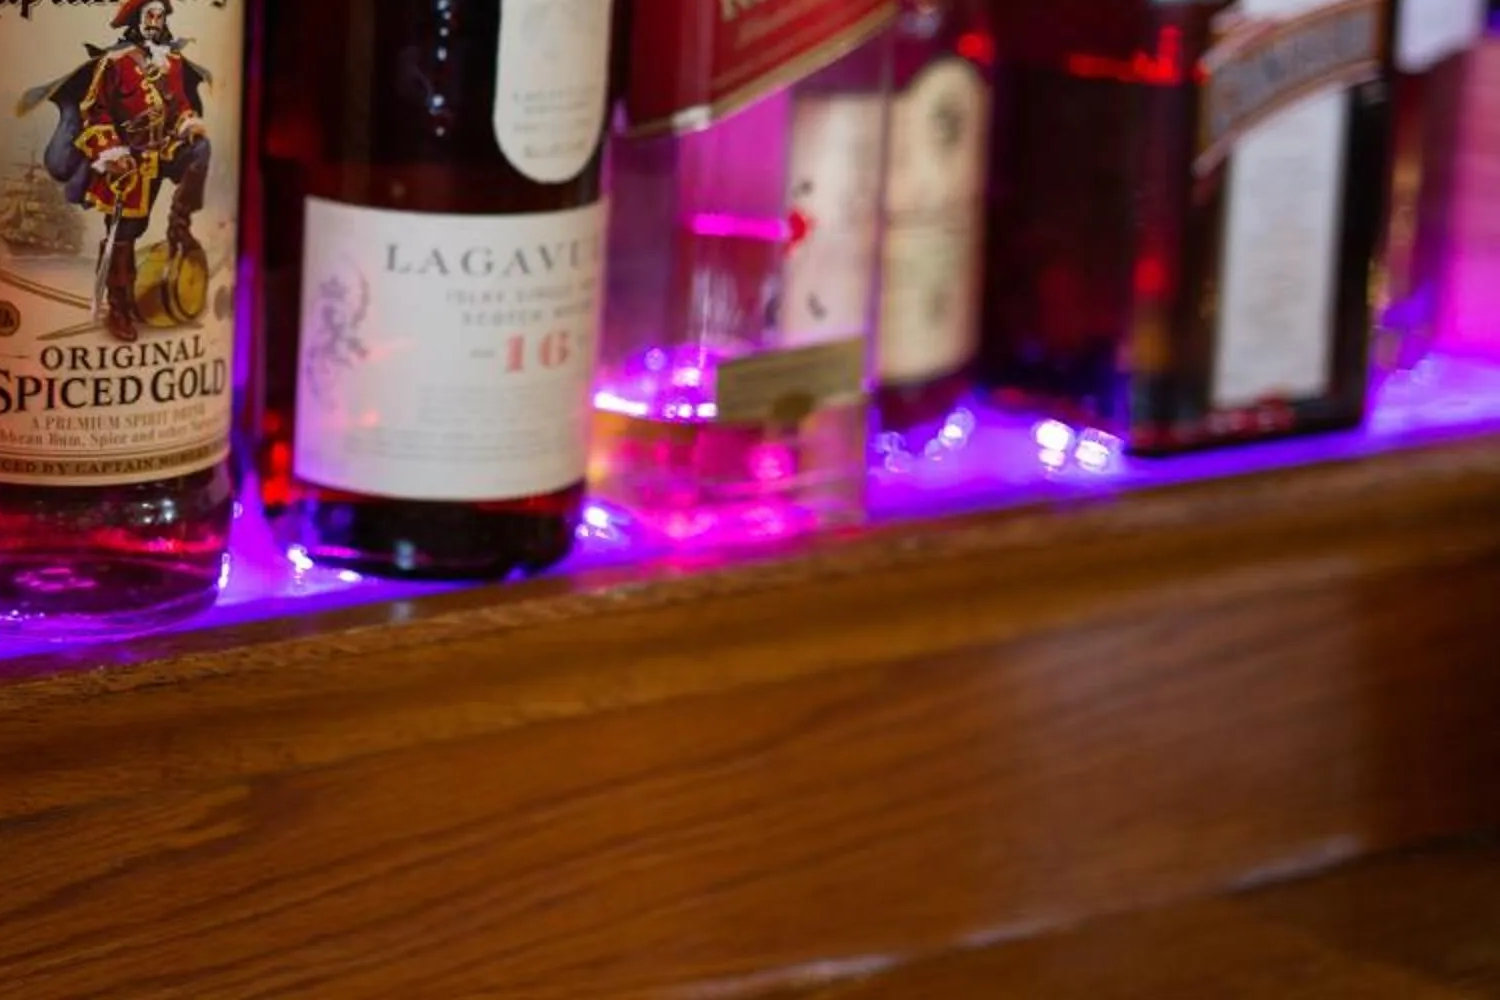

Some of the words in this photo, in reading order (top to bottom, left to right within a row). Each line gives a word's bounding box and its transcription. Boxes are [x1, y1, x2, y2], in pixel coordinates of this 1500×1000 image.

[39, 334, 206, 372] ORIGINAL
[504, 329, 572, 374] 16
[151, 358, 227, 403] GOLD
[45, 415, 120, 431] PREMIUM
[74, 457, 154, 475] CAPTAIN
